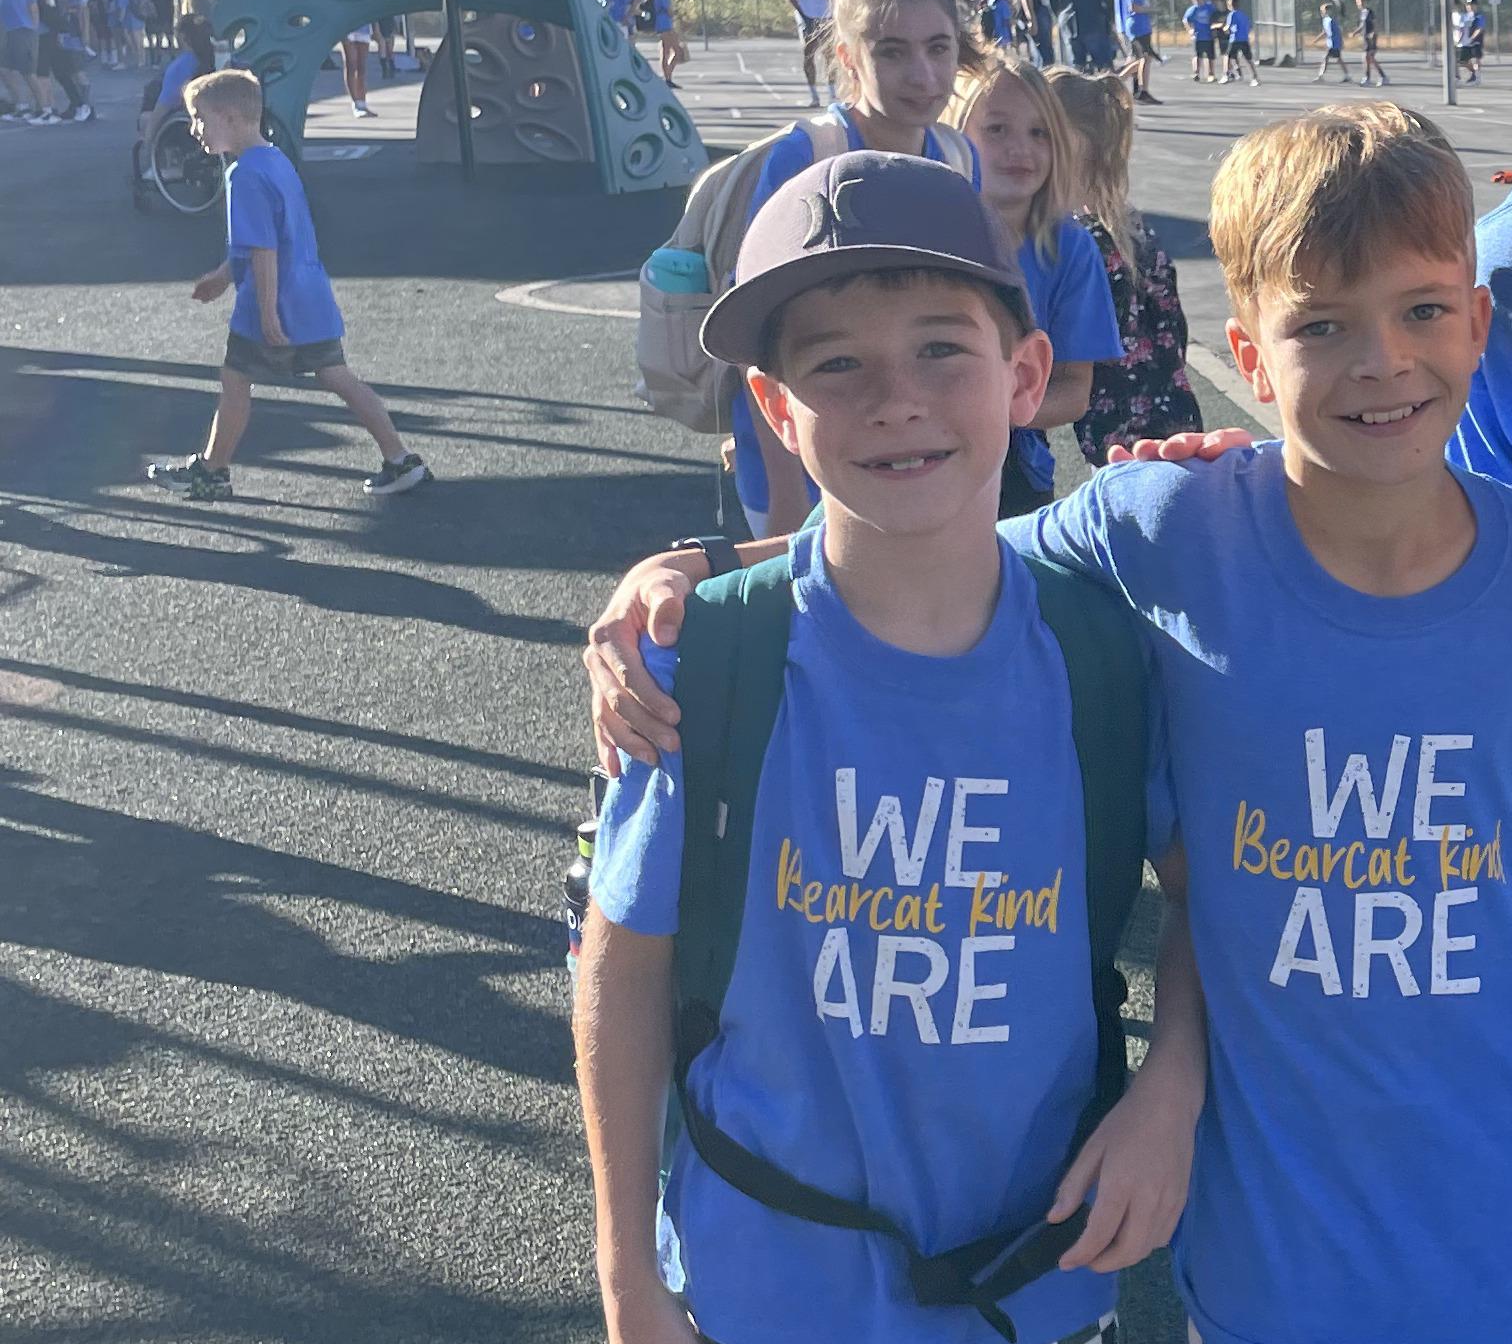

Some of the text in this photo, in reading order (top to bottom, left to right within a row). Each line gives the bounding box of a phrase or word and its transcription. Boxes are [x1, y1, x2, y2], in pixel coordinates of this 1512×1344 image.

[836, 767, 1009, 887] WE
[1304, 727, 1474, 841] WE
[776, 837, 1063, 938] Bearcat kind
[1233, 799, 1416, 889] Bearcat
[813, 927, 1016, 1045] ARE
[1268, 886, 1481, 998] ARE
